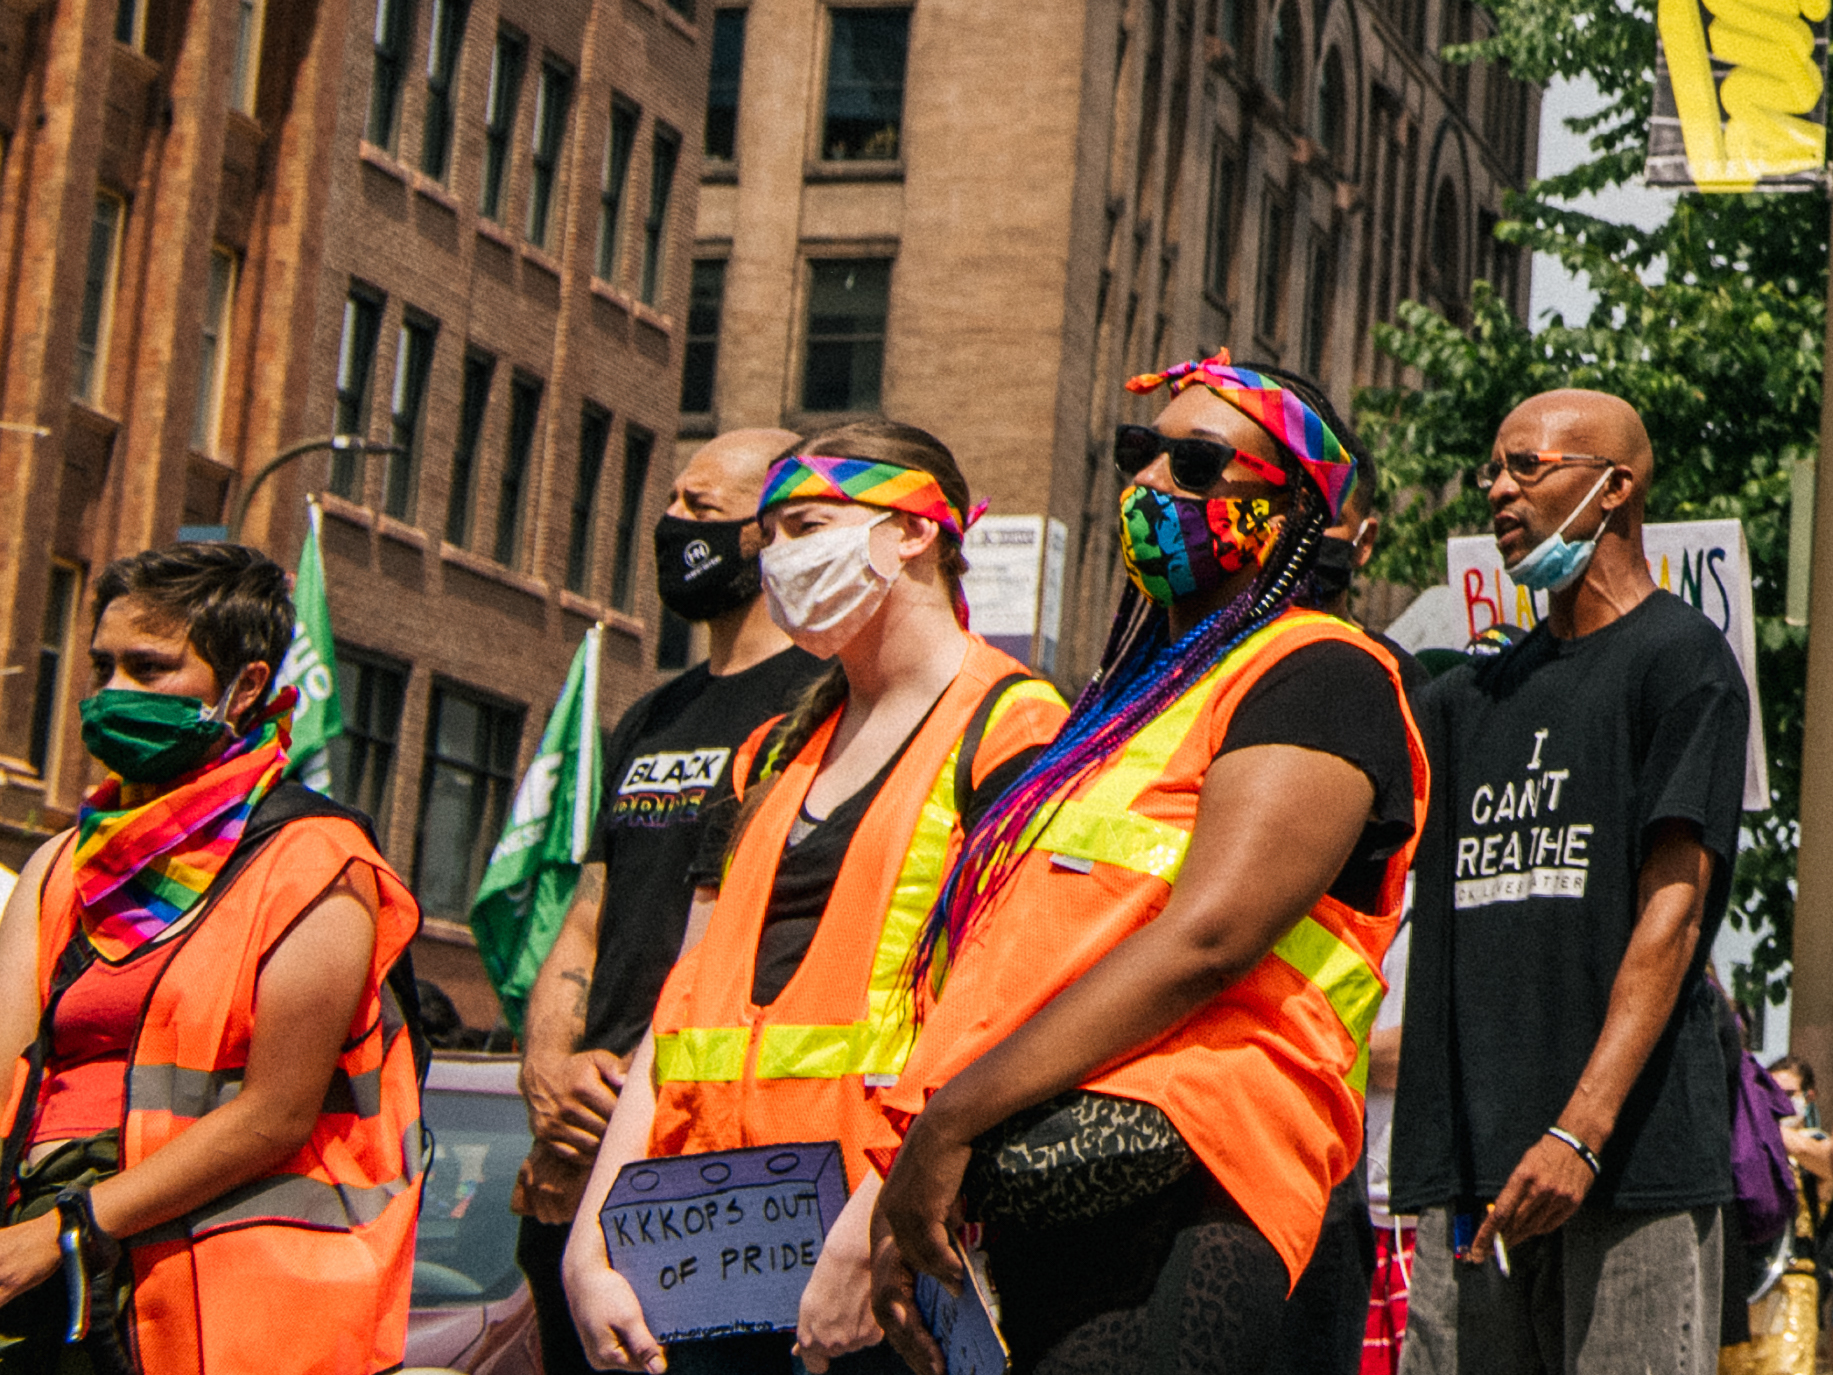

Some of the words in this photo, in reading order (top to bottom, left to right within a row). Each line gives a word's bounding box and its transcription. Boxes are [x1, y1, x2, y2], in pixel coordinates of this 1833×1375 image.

[1463, 567, 1544, 638] BLA
[1646, 546, 1731, 635] ANS
[626, 754, 720, 787] BLACK
[1526, 727, 1549, 770] I
[1471, 768, 1570, 825] CAN'T
[1455, 824, 1594, 878] REATHE
[613, 1197, 744, 1247] KKKOPS
[764, 1192, 818, 1222] OUT
[659, 1256, 697, 1290] OF
[720, 1240, 817, 1281] PRIDE
